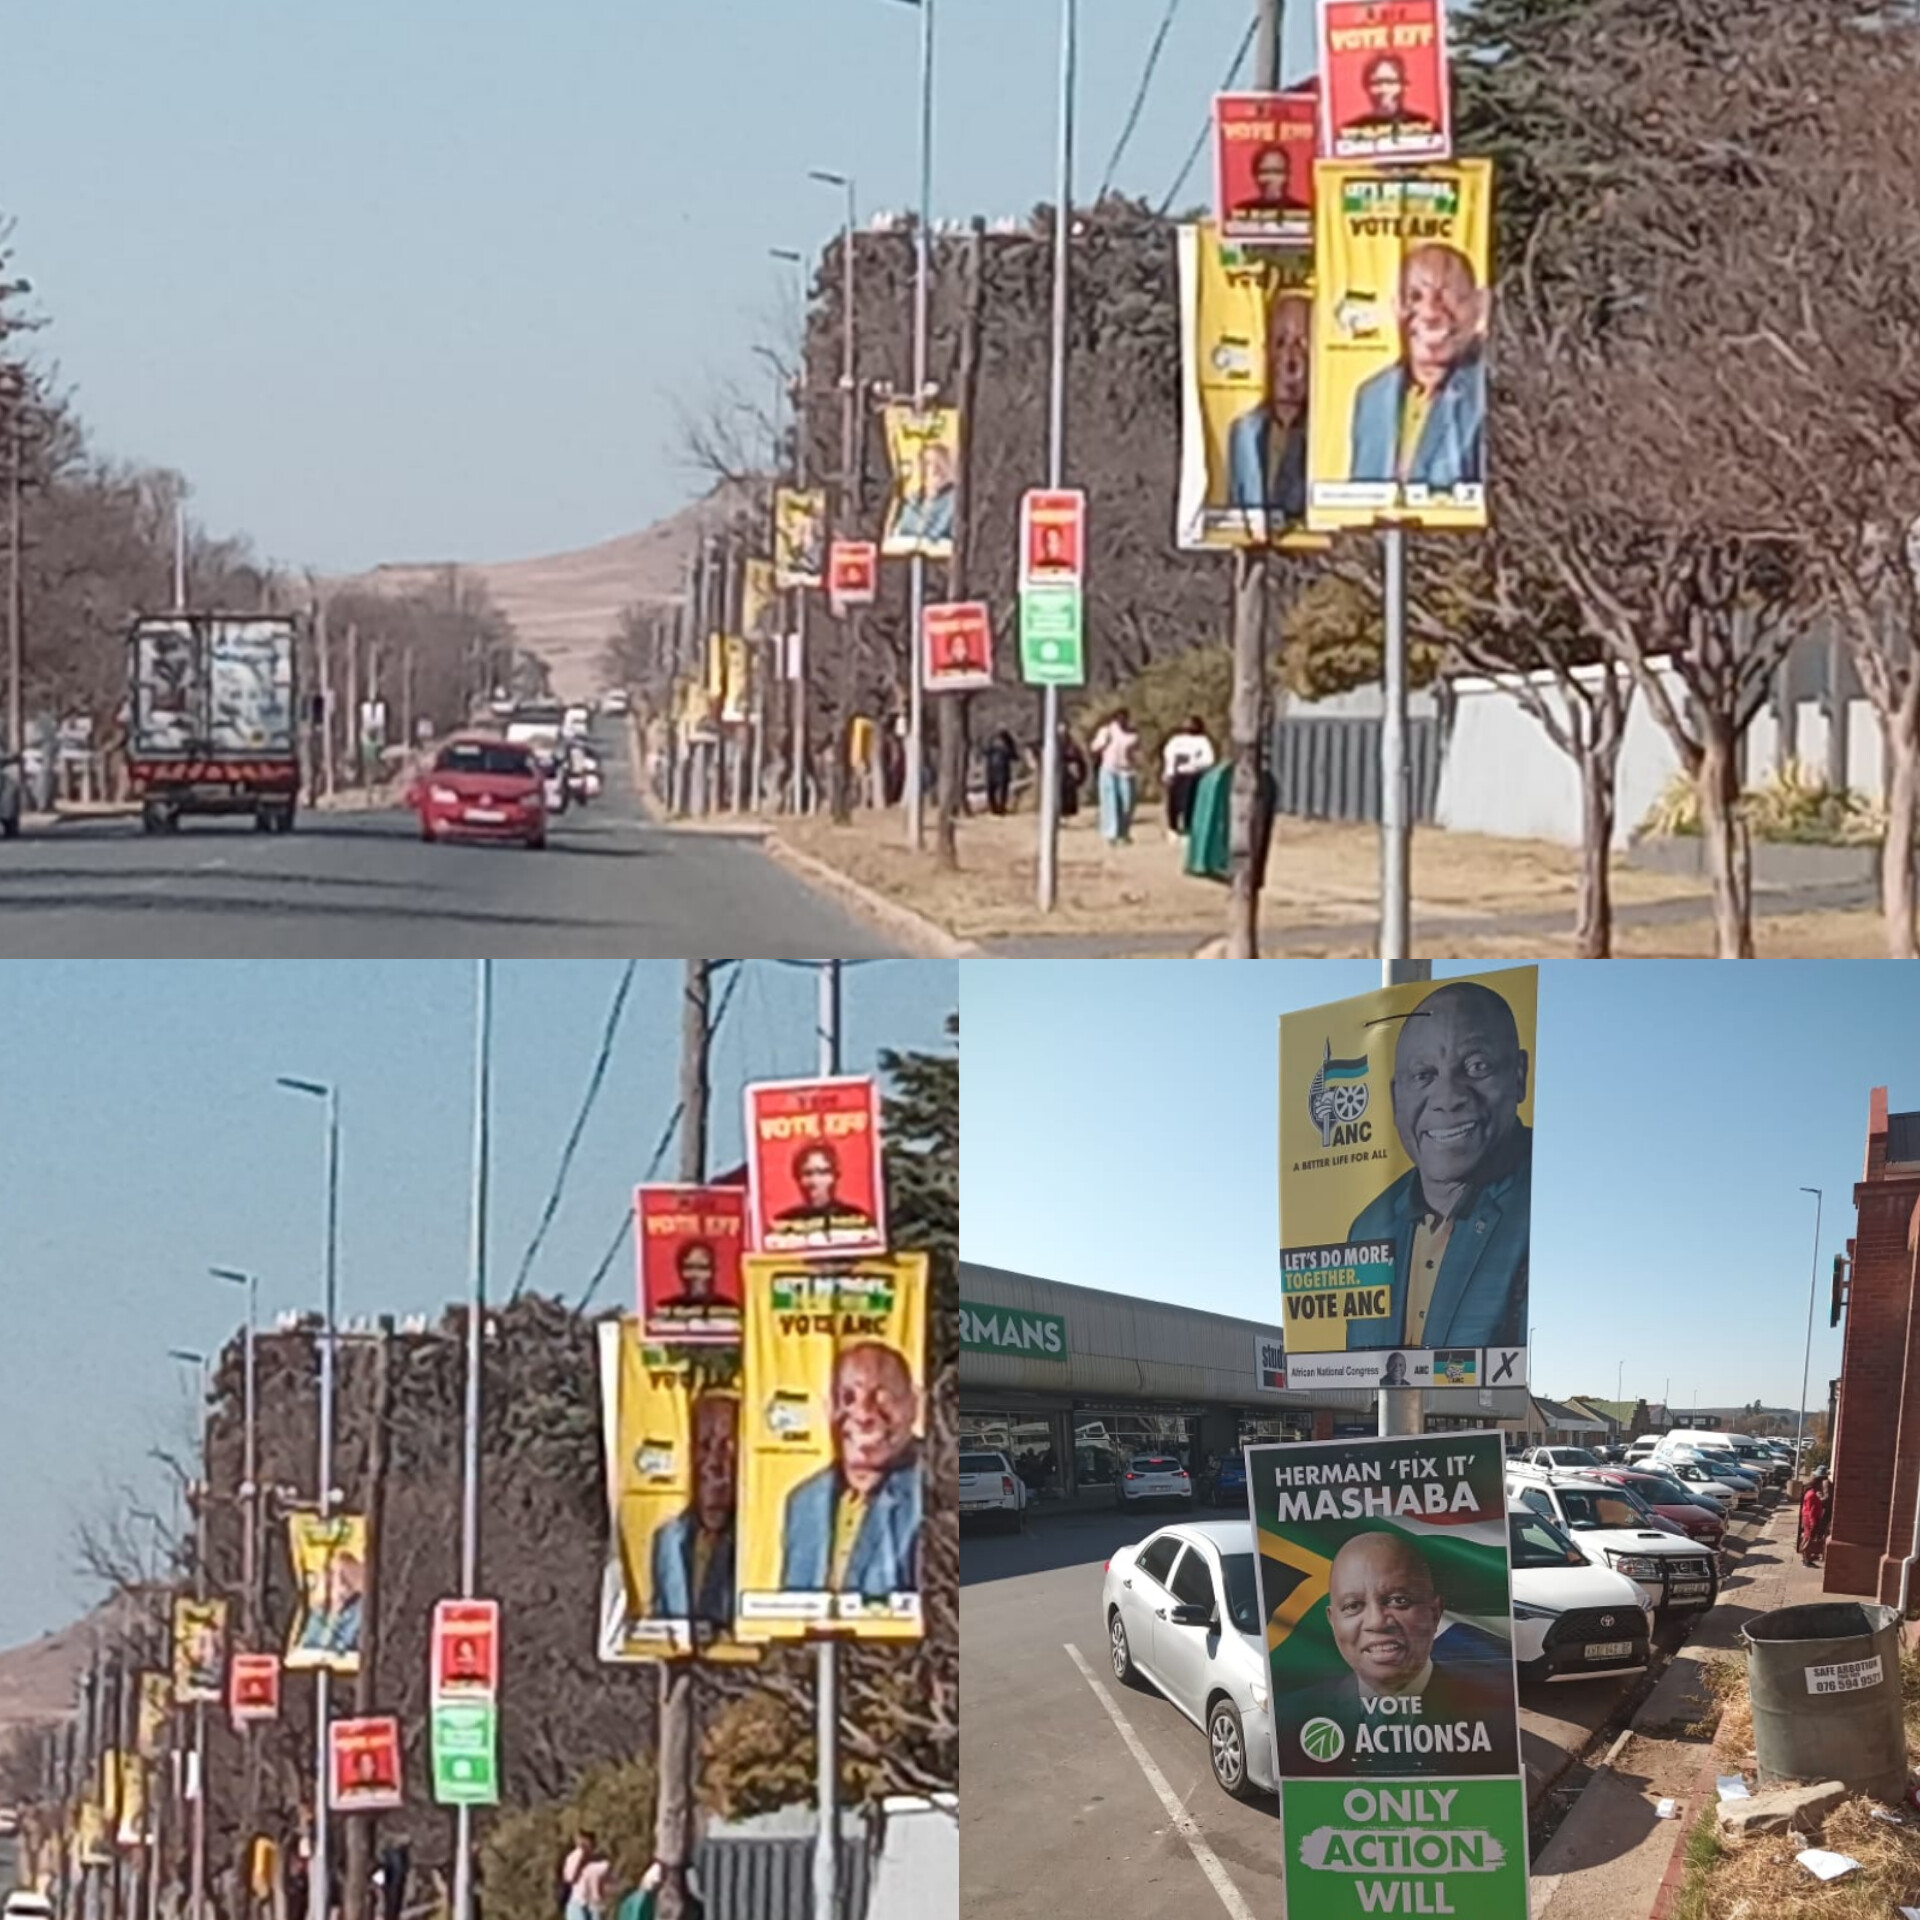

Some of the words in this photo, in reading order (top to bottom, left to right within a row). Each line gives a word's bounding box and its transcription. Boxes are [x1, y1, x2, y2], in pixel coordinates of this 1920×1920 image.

[1350, 218, 1402, 237] VOTE
[1409, 216, 1453, 237] ANC
[1332, 1121, 1372, 1147] ANC
[1293, 1162, 1300, 1172] A
[1302, 1157, 1330, 1170] BETTER
[1332, 1154, 1348, 1166] LIFE
[1351, 1152, 1369, 1163] FOR
[1372, 1149, 1388, 1160] ALL
[1284, 1251, 1317, 1271] LET'S
[1321, 1249, 1342, 1268] DO
[1344, 1244, 1395, 1266] MORE,
[1285, 1268, 1361, 1290] TOGETHER.
[1286, 1293, 1338, 1320] VOTE
[1343, 1289, 1386, 1317] ANC
[780, 1315, 835, 1336] VOTE
[842, 1314, 888, 1336] ANC
[1291, 1367, 1315, 1377] African
[1317, 1365, 1345, 1376] National
[1346, 1366, 1379, 1378] Congress
[1275, 1461, 1382, 1487] HERMAN
[1277, 1481, 1480, 1523] MASHABA
[1813, 1666, 1835, 1677] SAFE
[1816, 1681, 1836, 1692] 076
[1838, 1678, 1859, 1690] 594
[1361, 1696, 1422, 1715] VOTE
[1355, 1721, 1492, 1754] ACTIONSA
[1343, 1788, 1459, 1822] ONLY
[1322, 1834, 1485, 1868] ACTION
[1355, 1880, 1455, 1914] WILL
